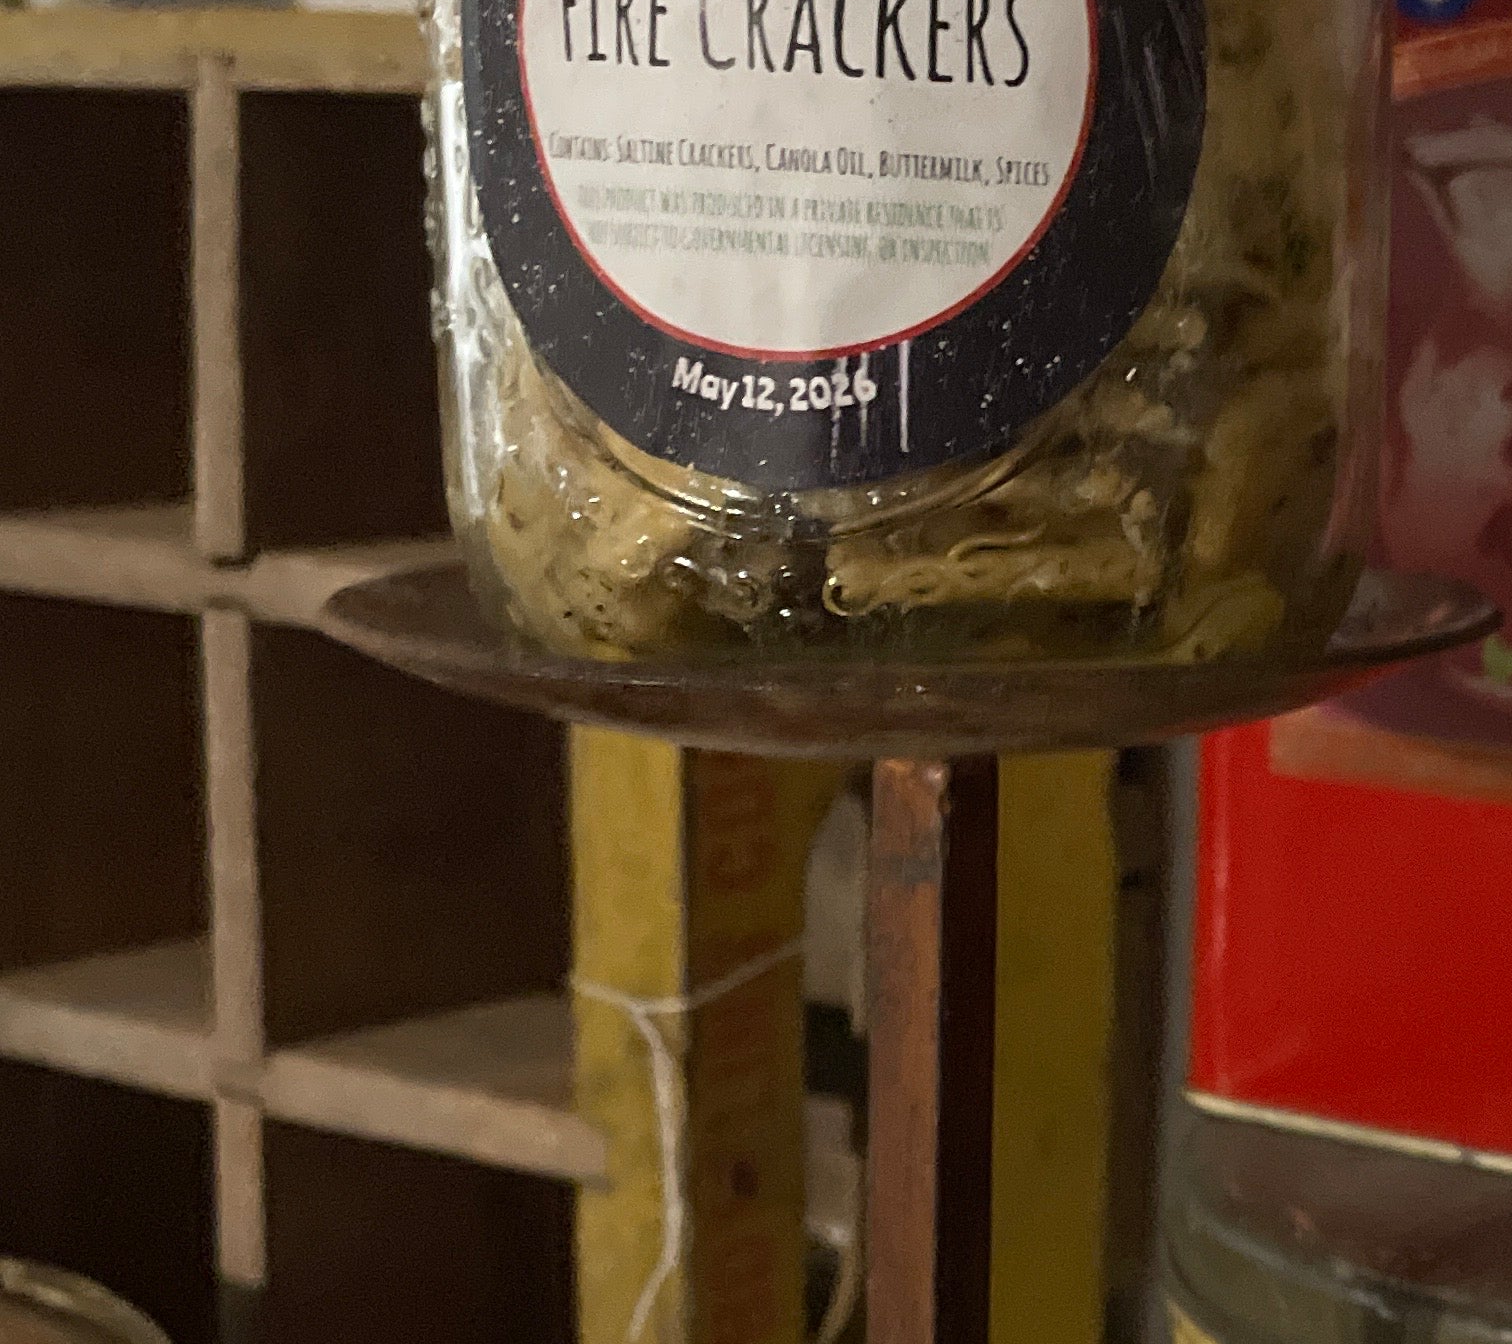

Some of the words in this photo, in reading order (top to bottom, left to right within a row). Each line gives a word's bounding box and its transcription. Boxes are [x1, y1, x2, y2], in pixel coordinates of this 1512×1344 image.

[765, 142, 831, 174] CANOLA
[996, 155, 1049, 186] SPICES
[671, 356, 740, 411] May
[741, 375, 785, 417] 12,
[789, 368, 878, 412] 2026
